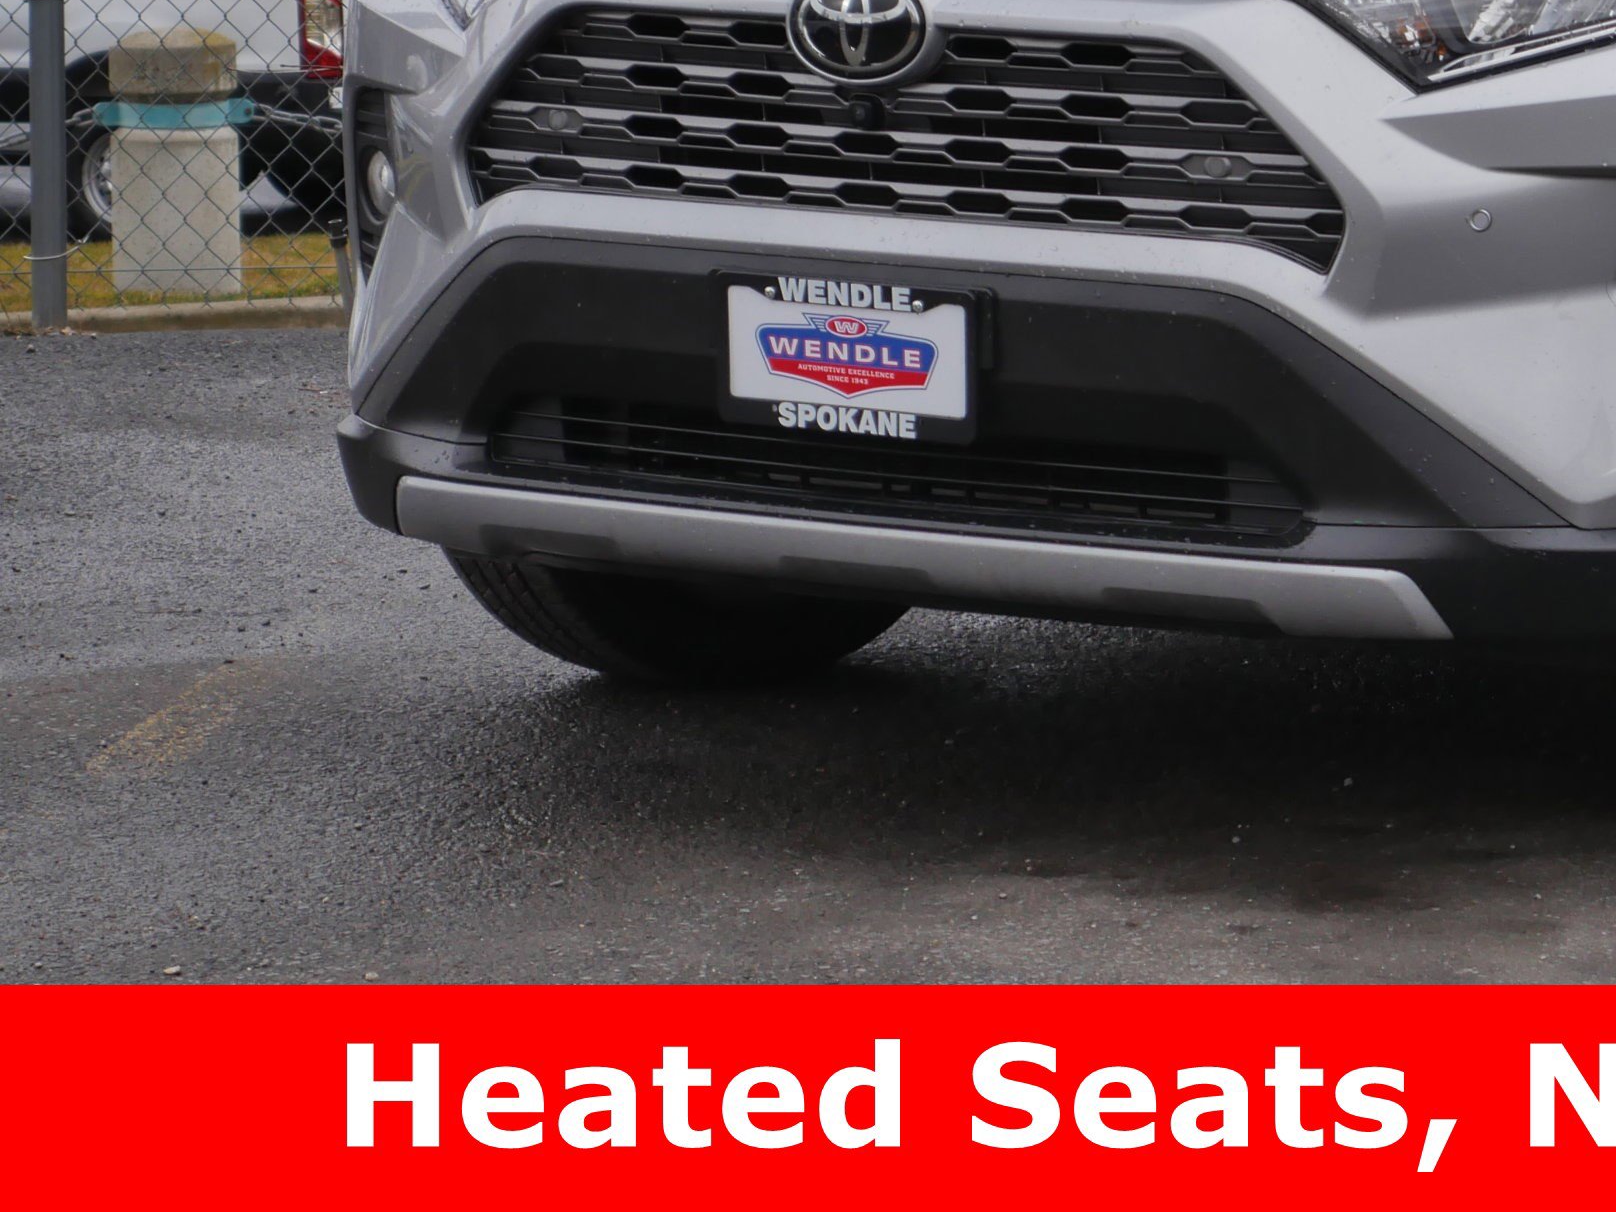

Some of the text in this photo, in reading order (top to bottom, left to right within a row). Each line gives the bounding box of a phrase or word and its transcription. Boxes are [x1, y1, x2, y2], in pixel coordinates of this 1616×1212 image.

[777, 276, 913, 313] WENDLE
[768, 335, 922, 369] WENDLE
[797, 363, 895, 380] AUTOMOTIVE EXCELLENCE
[826, 375, 869, 386] SINCE 1943
[778, 401, 917, 440] SPOKANE
